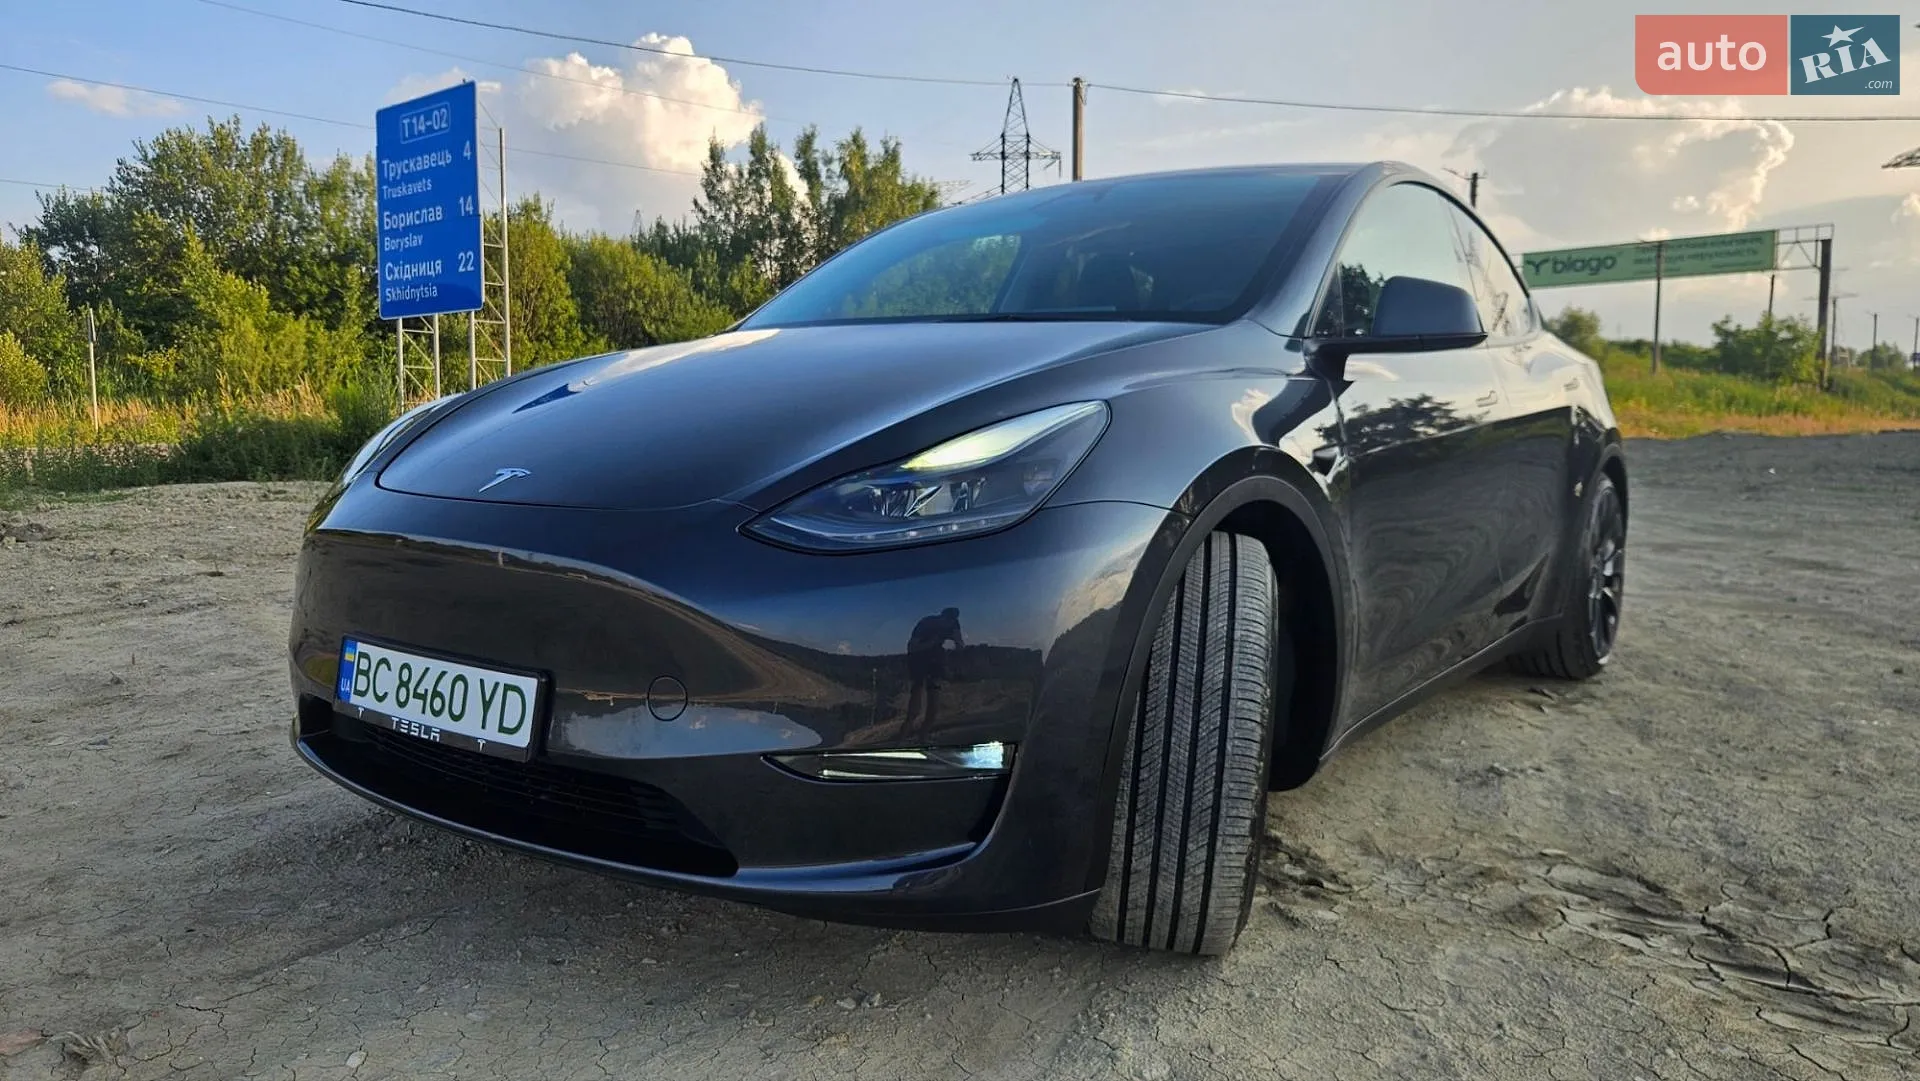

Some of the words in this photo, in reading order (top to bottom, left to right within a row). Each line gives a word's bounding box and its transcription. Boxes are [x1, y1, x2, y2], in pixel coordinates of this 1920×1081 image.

[382, 150, 452, 181] Трускавець
[463, 141, 471, 160] 4
[382, 178, 432, 200] Truskavets
[384, 206, 443, 231] Борислав
[459, 195, 474, 217] 14
[384, 233, 423, 252] Boryslav
[385, 260, 442, 281] Східниця
[458, 251, 474, 272] 22
[385, 283, 438, 302] Skhidnytsia
[341, 677, 350, 694] UA
[353, 651, 392, 703] BC
[395, 662, 469, 722] 8460
[479, 678, 527, 735] YD
[391, 716, 440, 742] TESLA
